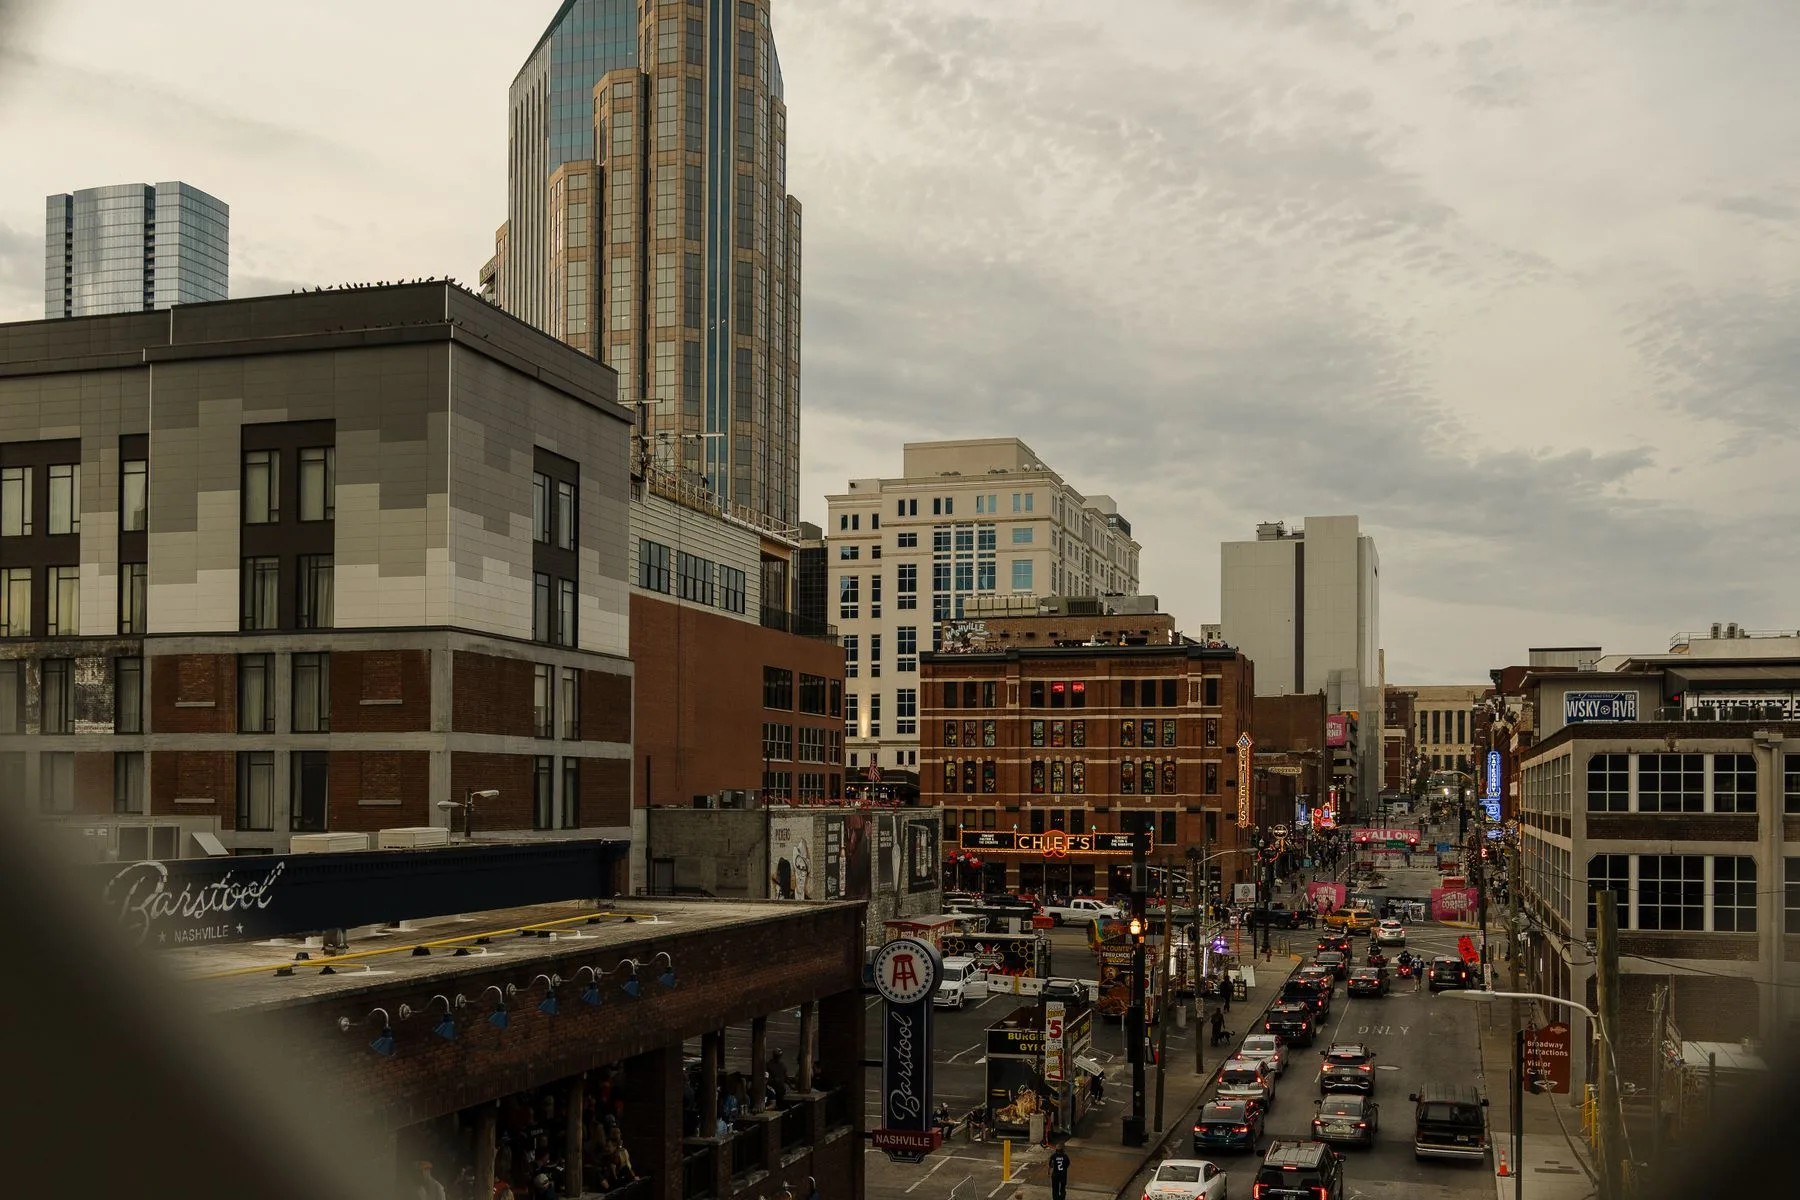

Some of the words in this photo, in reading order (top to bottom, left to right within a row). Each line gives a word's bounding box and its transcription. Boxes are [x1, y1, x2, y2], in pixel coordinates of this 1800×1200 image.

[945, 622, 985, 640] NASHVILLE
[1566, 700, 1601, 718] WSKY
[1612, 700, 1636, 718] RVR
[1700, 699, 1790, 709] WHISKEY
[1365, 830, 1394, 841] Y'ALL
[1395, 831, 1408, 841] ON
[1018, 836, 1090, 850] CHIEF'S
[102, 861, 286, 946] Barstool
[174, 924, 230, 944] NASHVILLE
[1527, 1040, 1564, 1050] Broadway
[1527, 1048, 1569, 1057] Attractions
[889, 1010, 921, 1121] Barstool
[1526, 1067, 1552, 1076] Cnter
[875, 1133, 931, 1148] NASHVILLE
